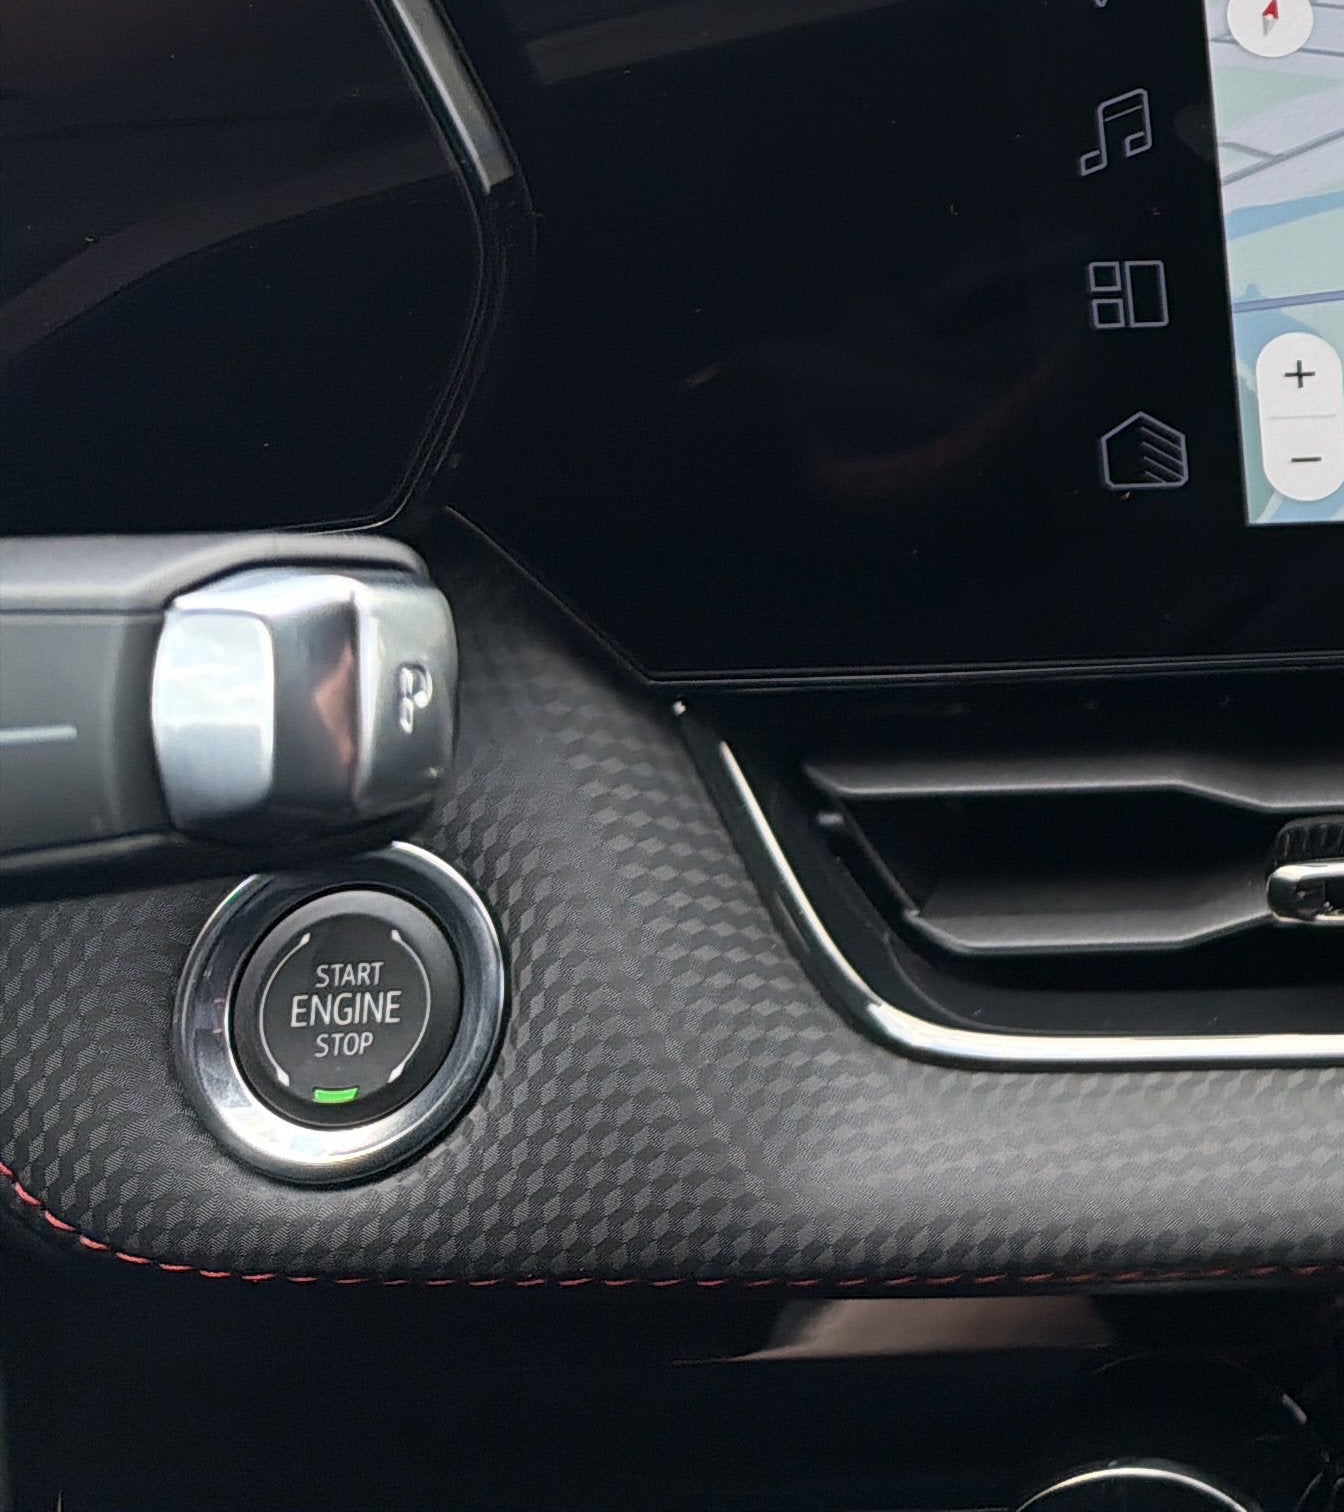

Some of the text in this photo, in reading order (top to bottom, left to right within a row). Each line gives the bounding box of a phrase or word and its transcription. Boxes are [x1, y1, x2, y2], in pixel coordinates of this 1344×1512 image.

[315, 961, 384, 988] START
[290, 990, 402, 1027] ENGINE
[315, 1031, 374, 1058] STOP
